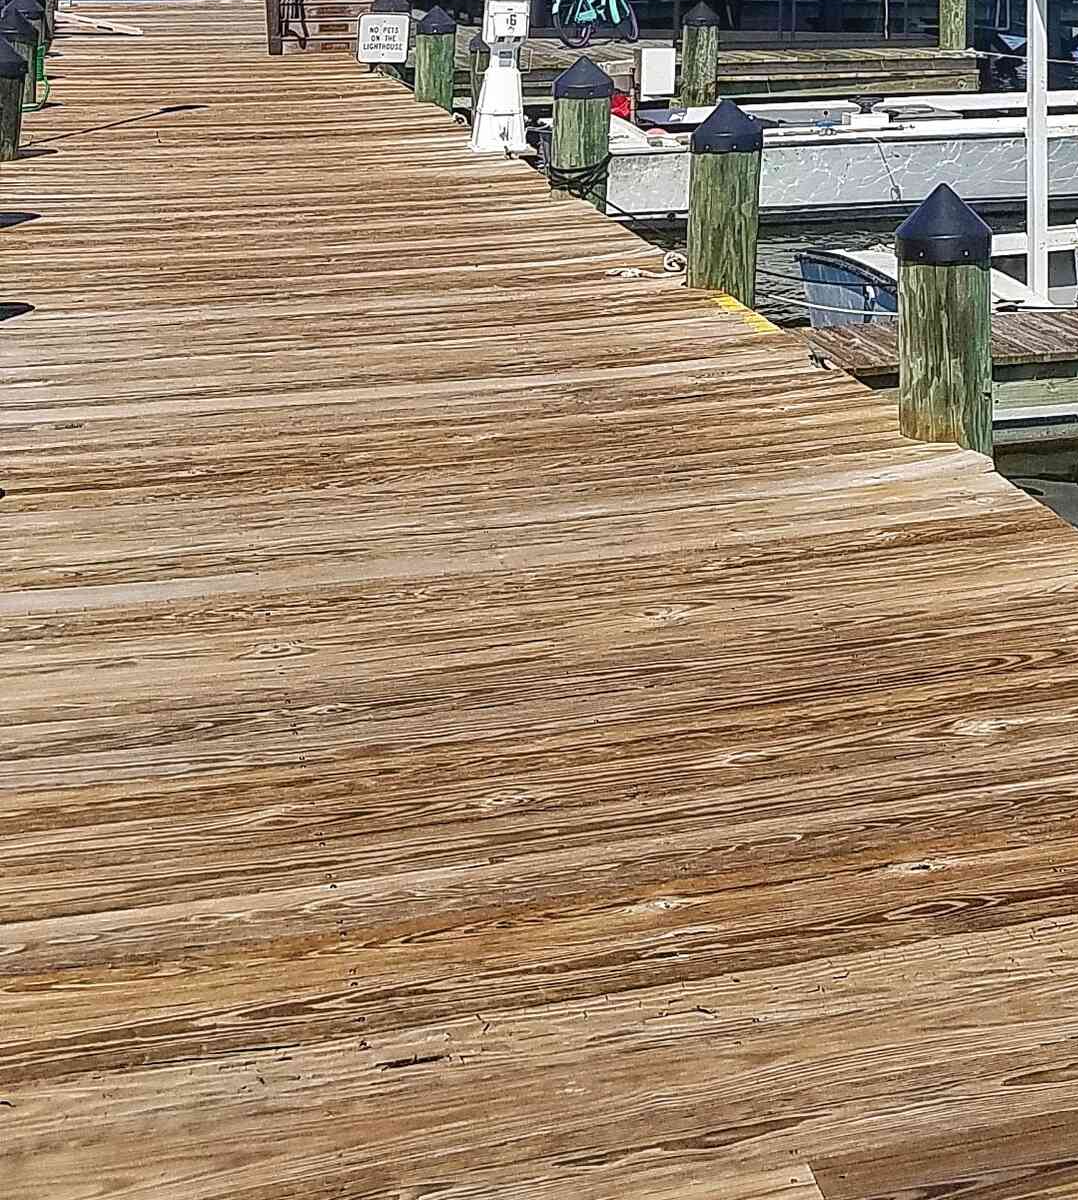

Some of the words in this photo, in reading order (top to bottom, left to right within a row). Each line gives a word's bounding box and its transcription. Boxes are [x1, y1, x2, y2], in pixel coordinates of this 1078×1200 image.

[369, 26, 380, 34] NO
[382, 26, 399, 34] PETS
[370, 34, 380, 42] ON
[385, 34, 397, 42] THE
[363, 42, 402, 50] LIGHTHOUSE
